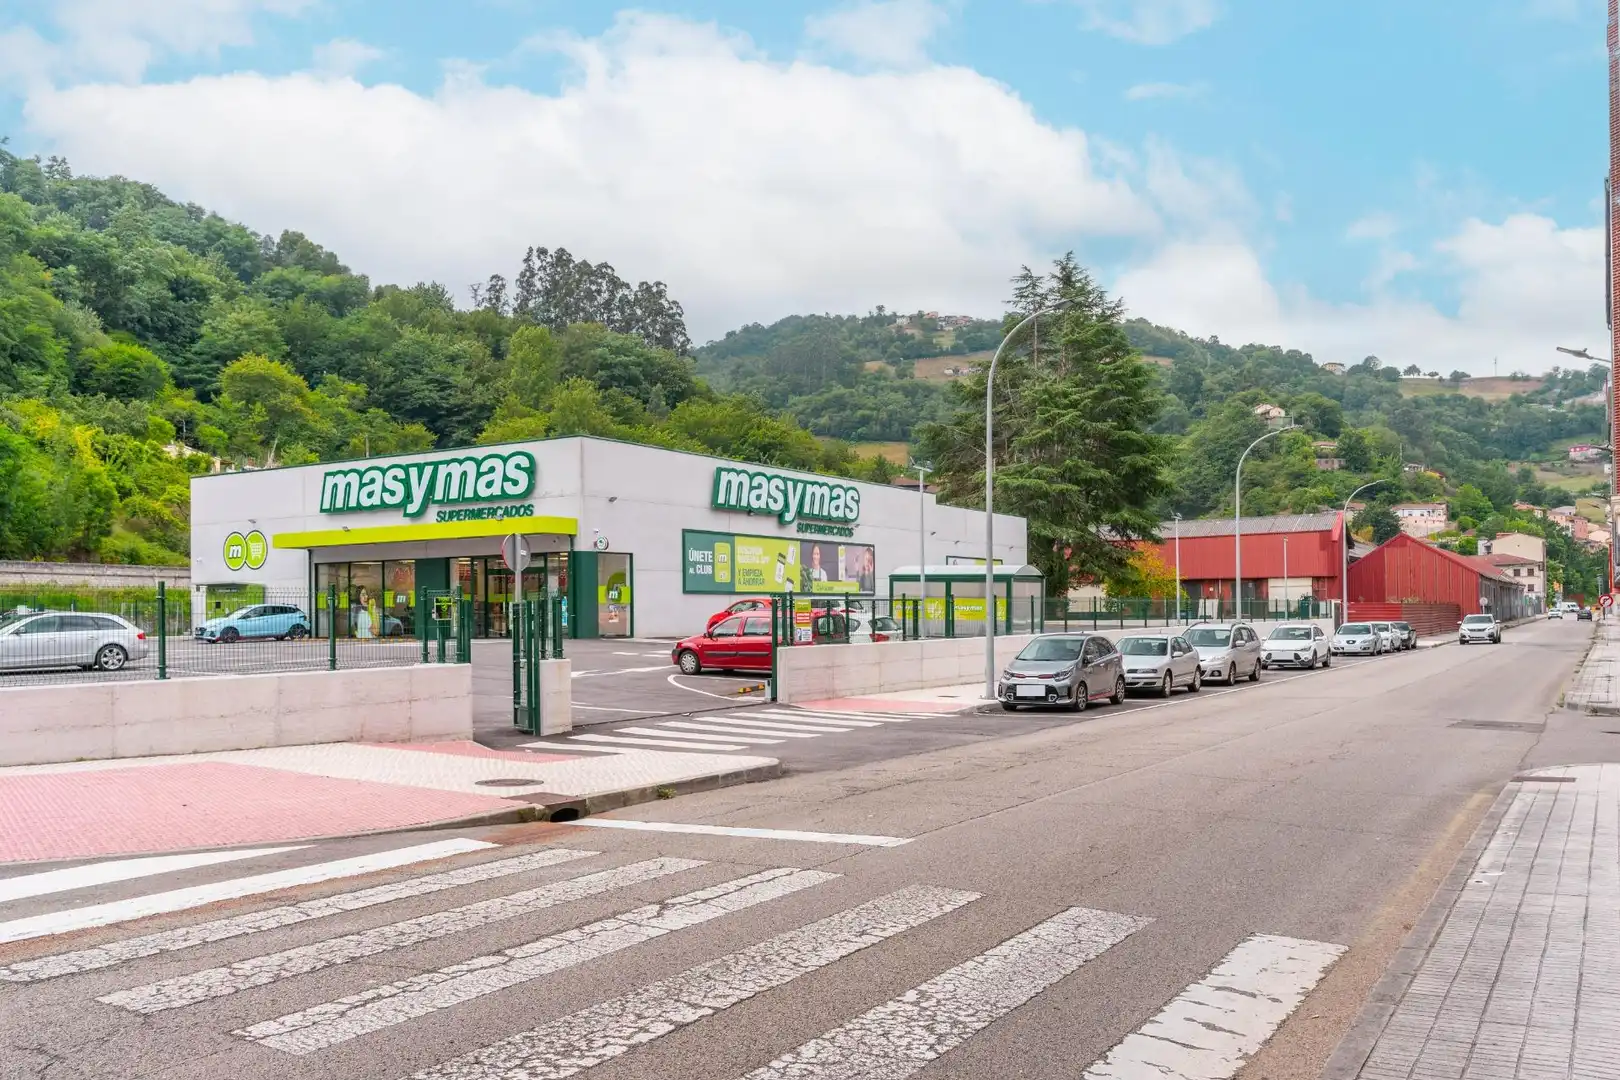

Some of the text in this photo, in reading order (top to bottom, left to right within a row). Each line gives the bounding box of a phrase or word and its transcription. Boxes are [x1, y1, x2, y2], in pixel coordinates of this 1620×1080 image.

[321, 453, 532, 516] masymas
[716, 469, 860, 523] masymas
[436, 504, 535, 523] SUPERMERCADOS
[797, 522, 855, 538] SUPERMERCADOS
[688, 548, 713, 563] ÚNETE
[696, 564, 713, 575] CLUB
